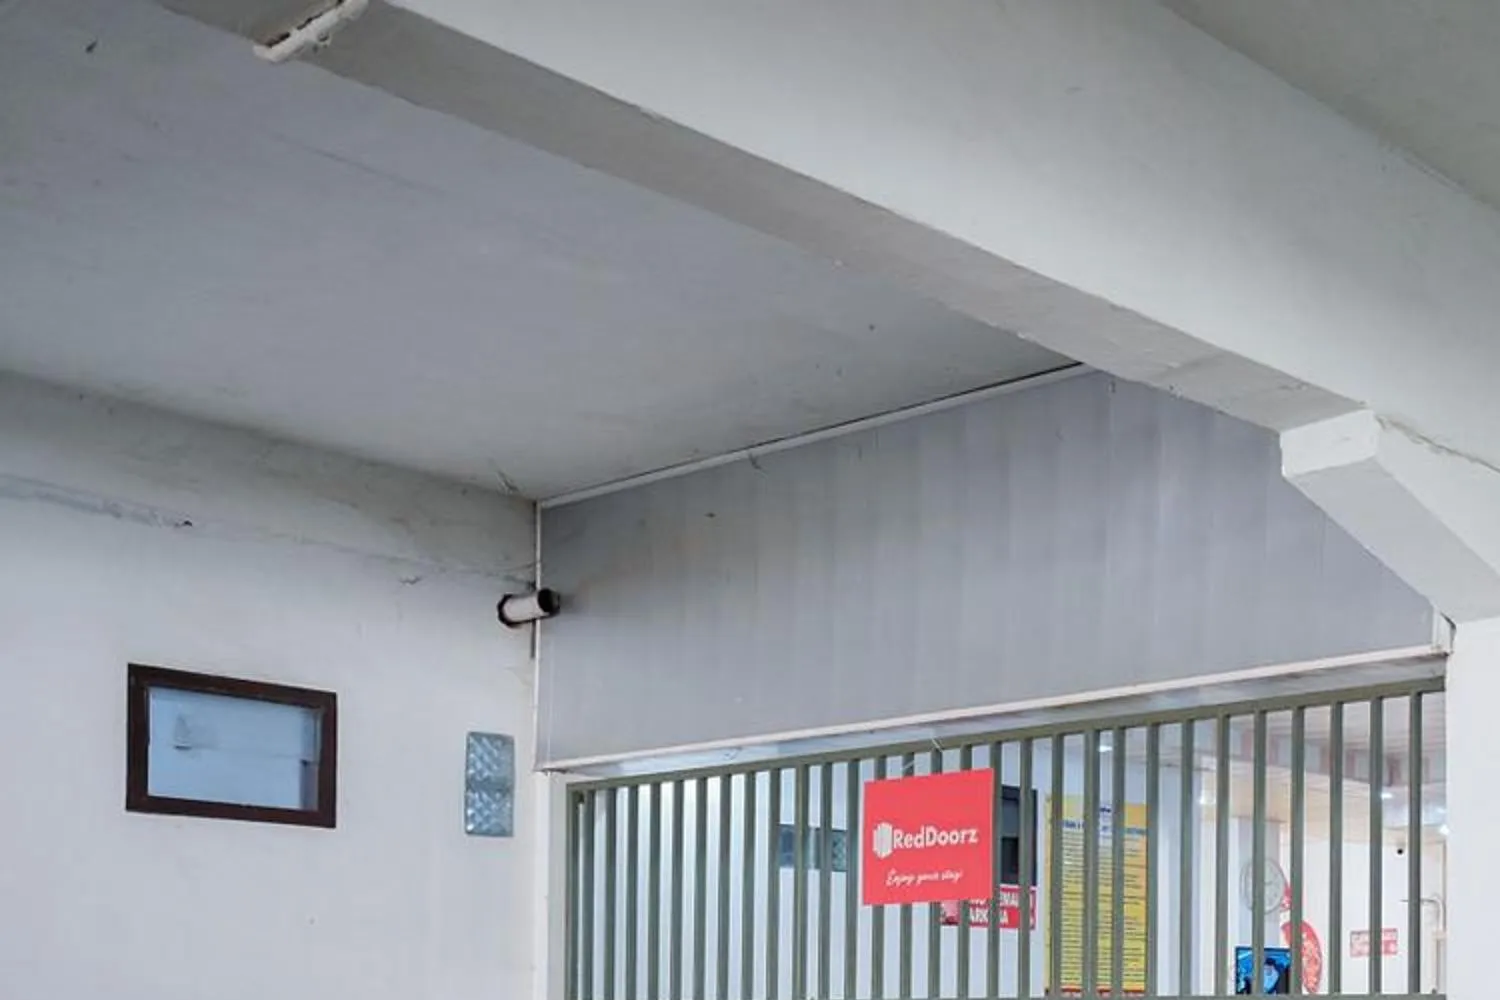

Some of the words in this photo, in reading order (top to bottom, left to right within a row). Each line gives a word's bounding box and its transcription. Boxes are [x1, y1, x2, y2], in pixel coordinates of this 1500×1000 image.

[893, 825, 978, 849] RedDoorz
[885, 868, 916, 887] Enjoy
[916, 873, 939, 885] your
